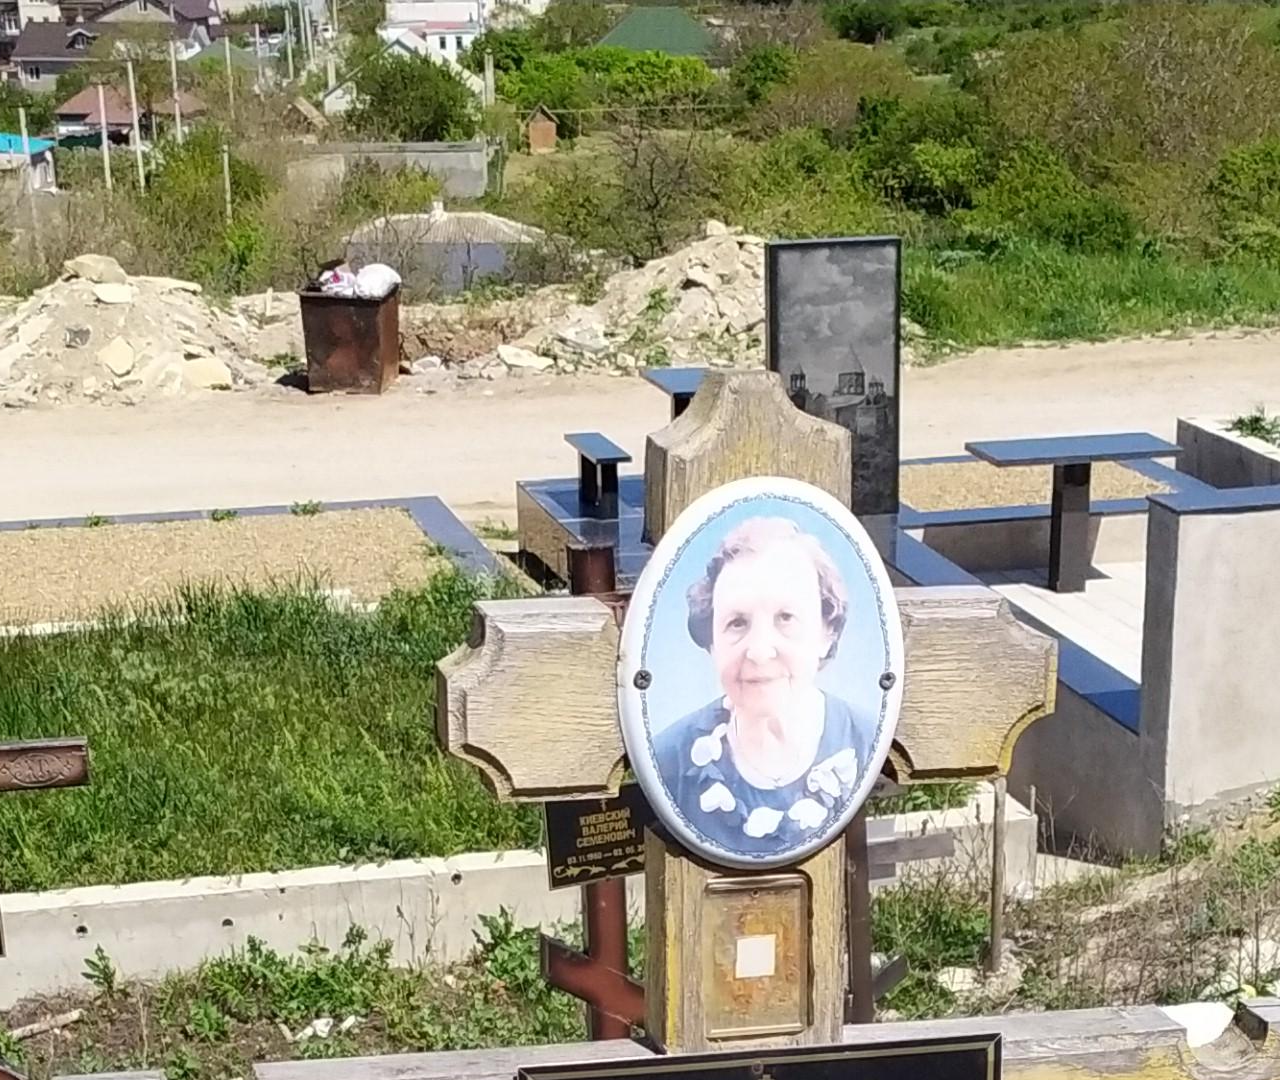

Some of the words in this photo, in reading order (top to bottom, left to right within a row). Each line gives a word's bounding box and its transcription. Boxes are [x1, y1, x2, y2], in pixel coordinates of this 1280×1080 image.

[580, 807, 631, 826] КИЕВСКИЙ
[582, 820, 628, 836] ВАЛЕРИЙ
[576, 828, 636, 848] СЕМЕНОВИЧ
